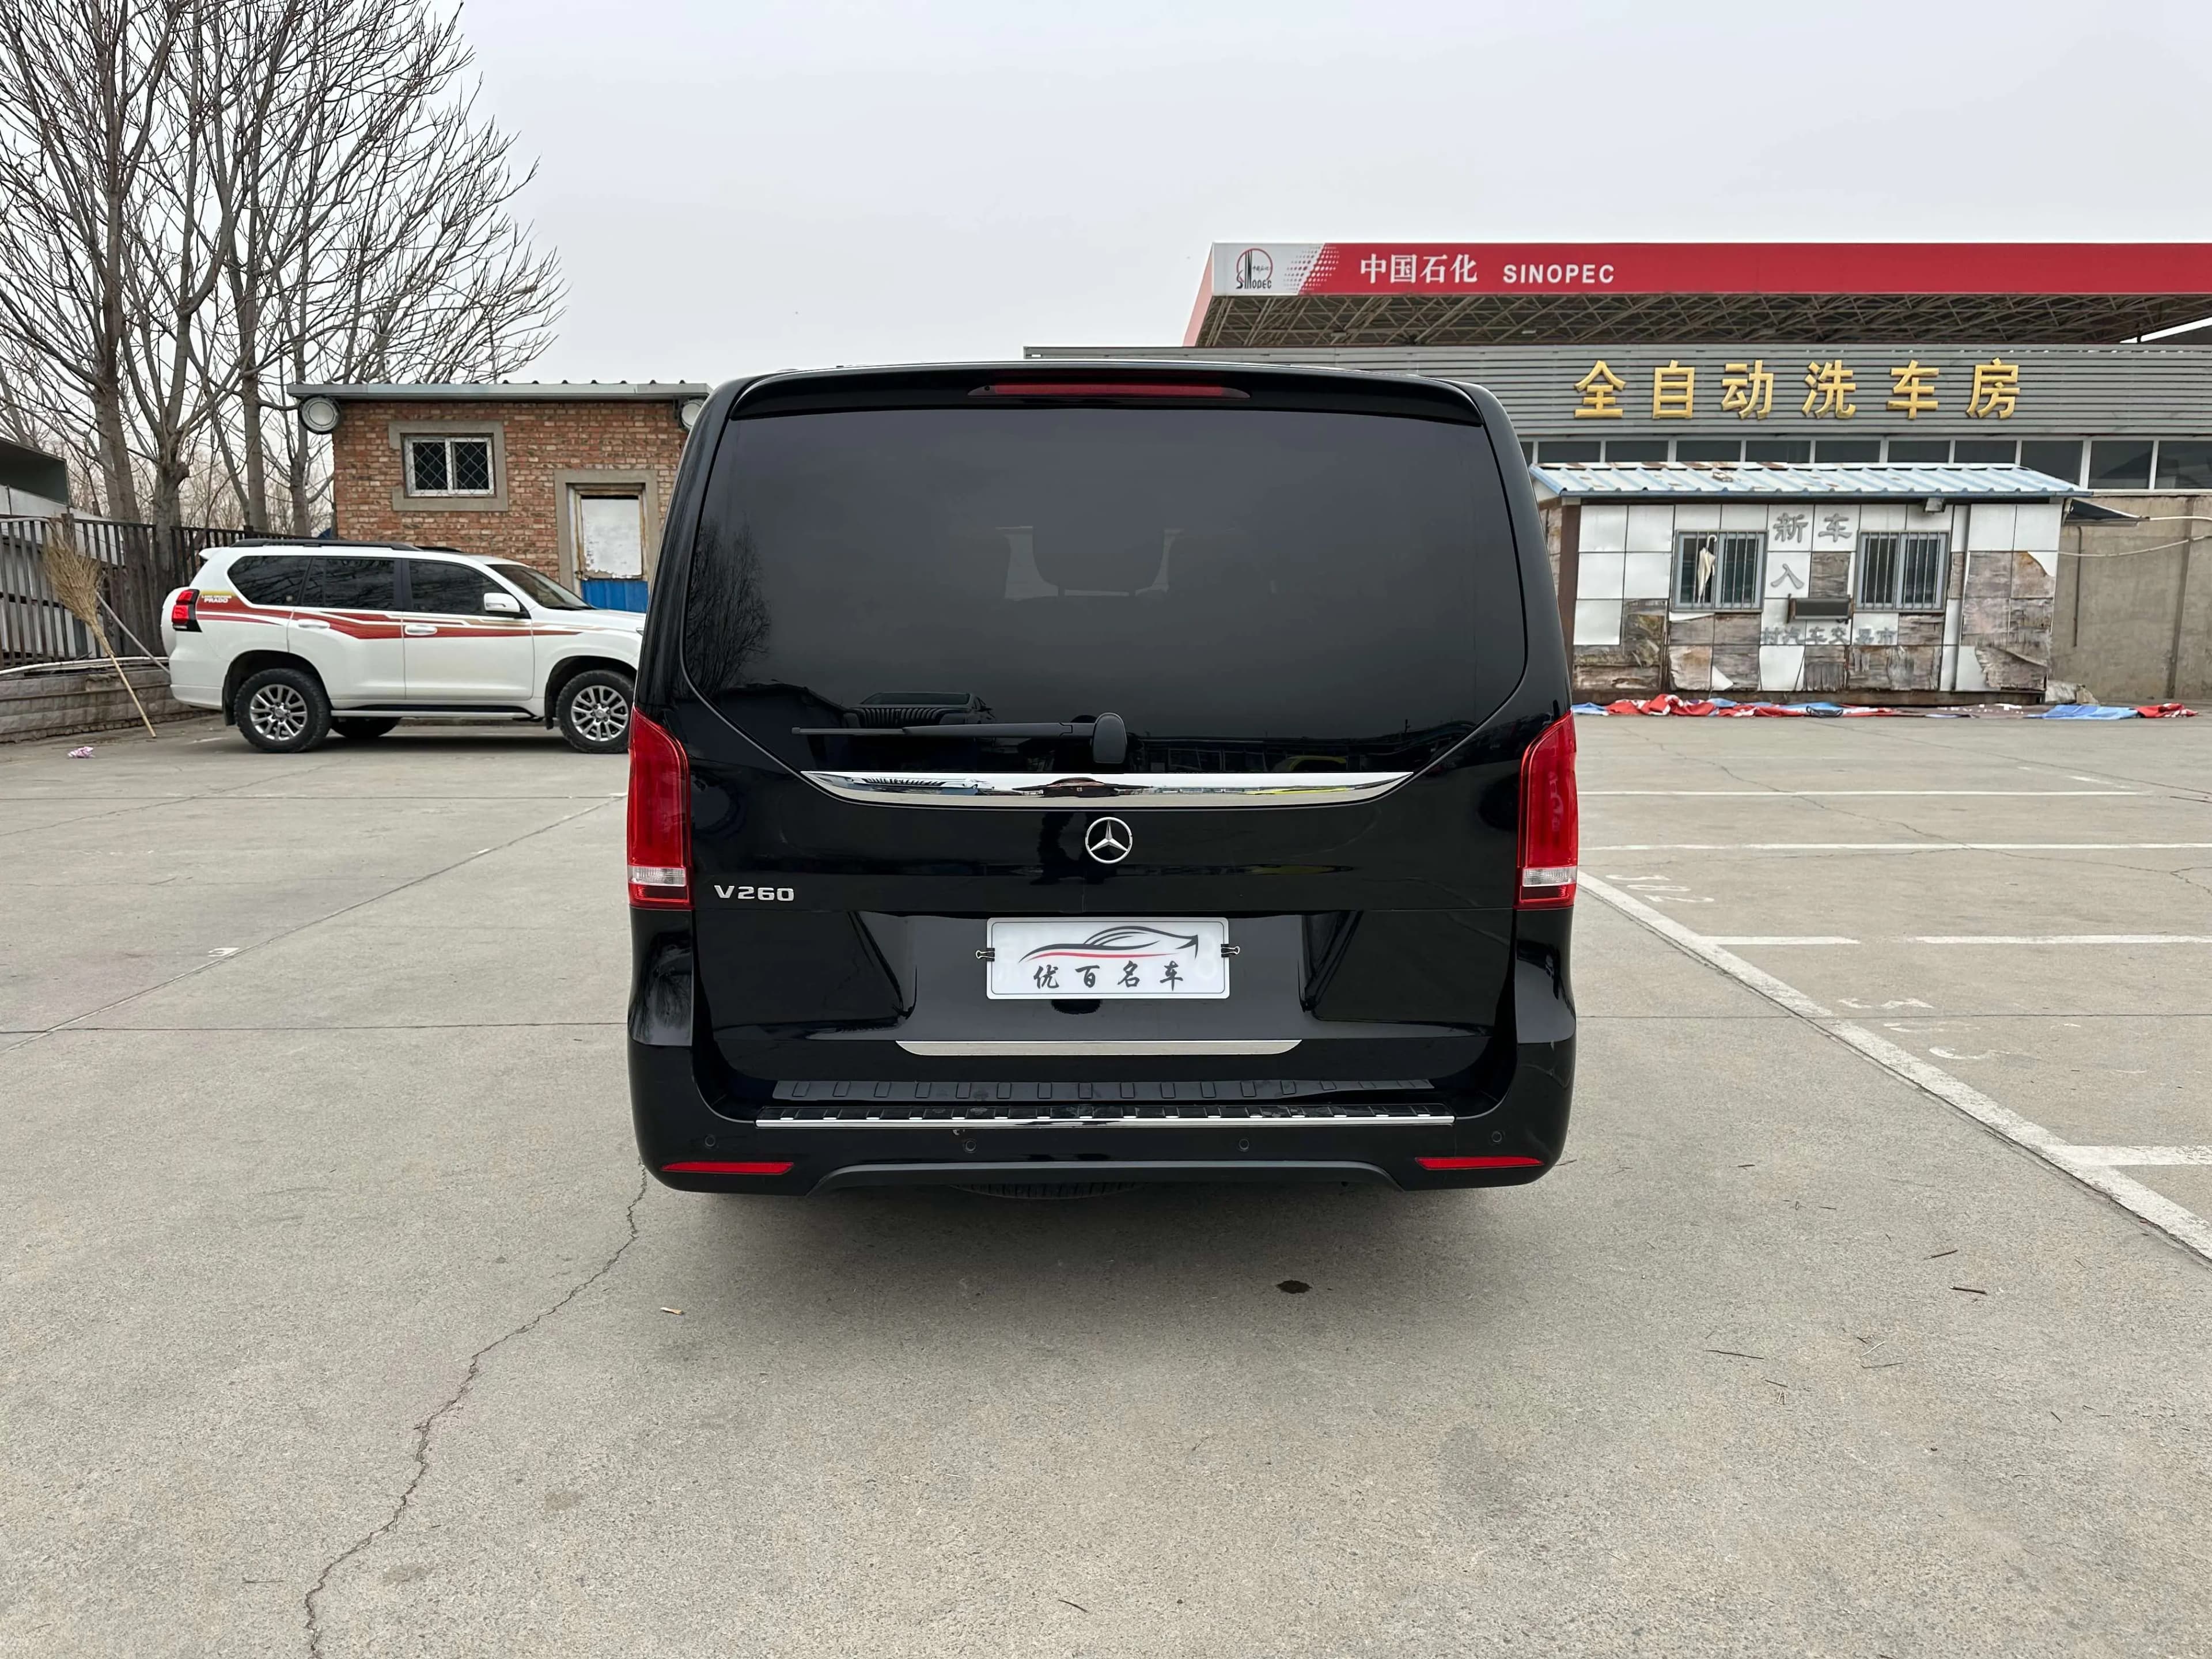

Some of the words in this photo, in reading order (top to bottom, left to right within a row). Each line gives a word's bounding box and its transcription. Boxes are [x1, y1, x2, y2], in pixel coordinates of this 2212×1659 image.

[1361, 253, 1478, 284] 中国石化
[1503, 264, 1614, 283] SINOPEC
[1574, 358, 2020, 419] 全自动洗车房
[1773, 512, 1853, 543] 新车
[1770, 563, 1804, 589] 入
[714, 885, 794, 902] V260
[1033, 960, 1183, 991] 优百名车
